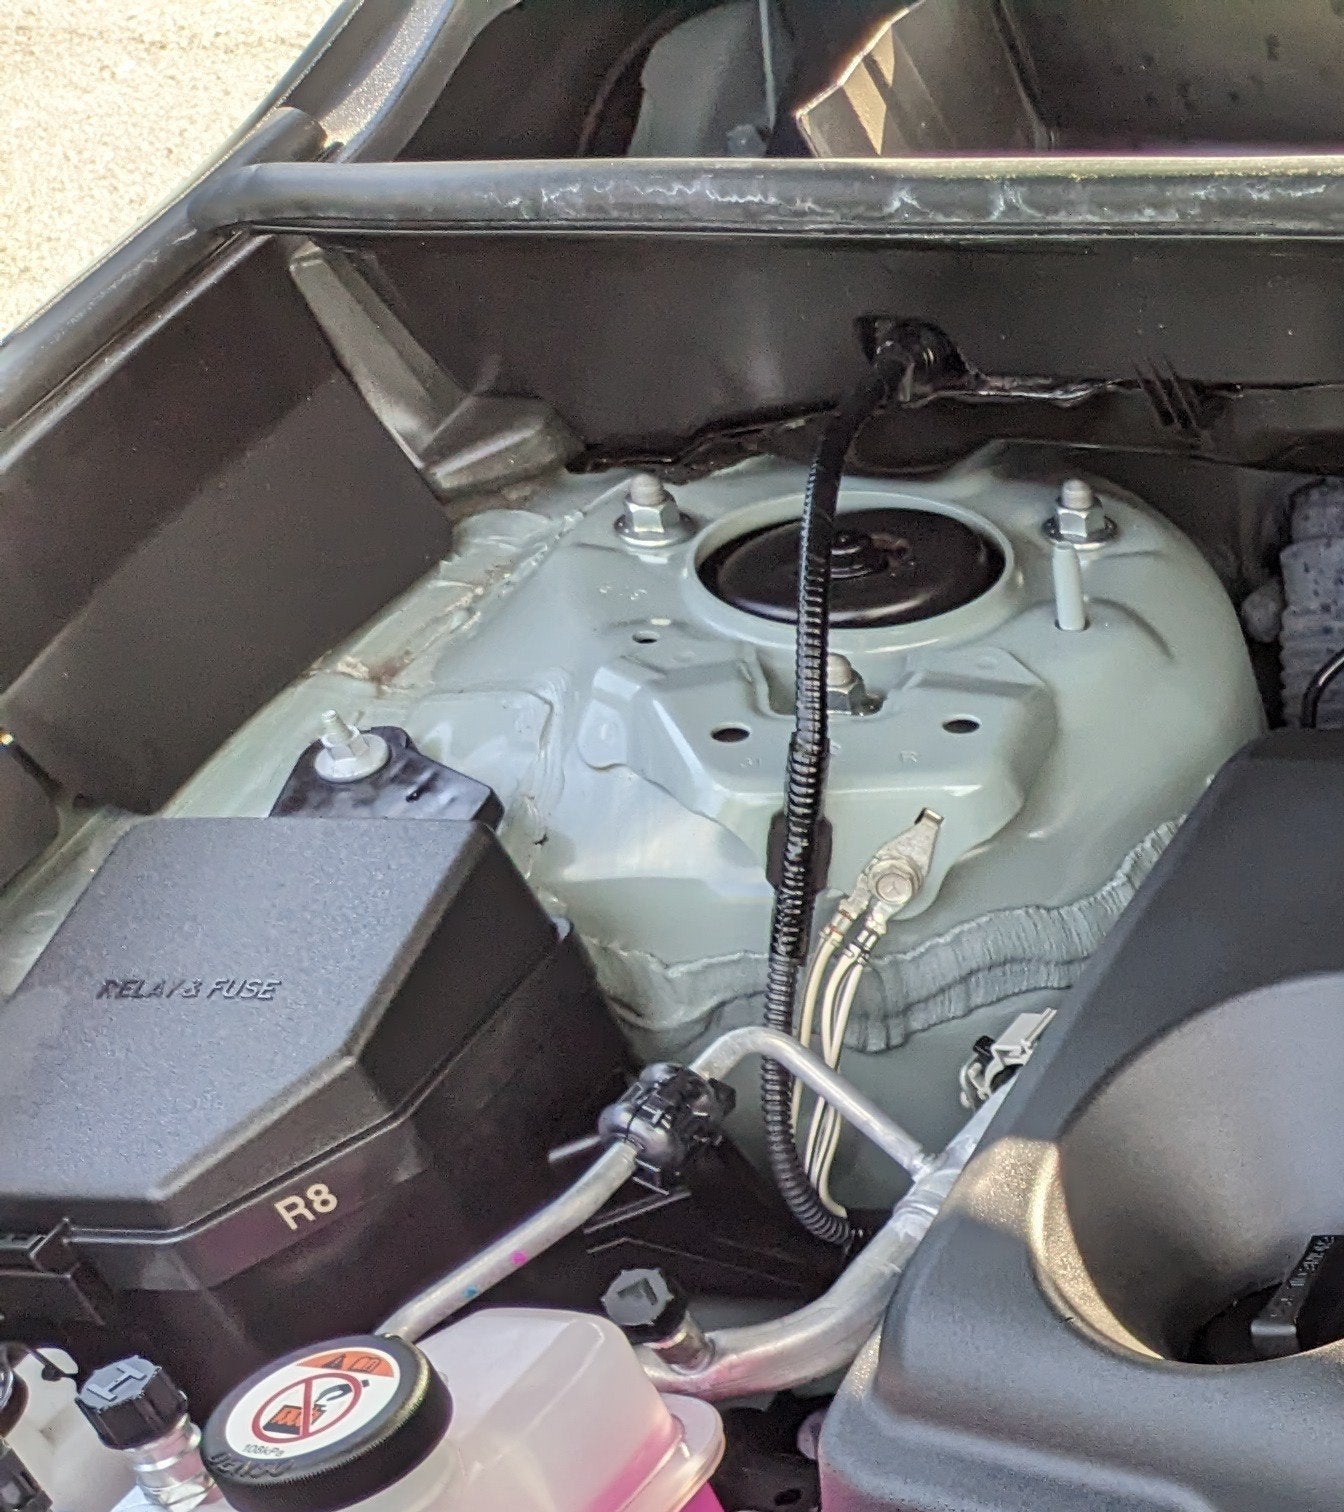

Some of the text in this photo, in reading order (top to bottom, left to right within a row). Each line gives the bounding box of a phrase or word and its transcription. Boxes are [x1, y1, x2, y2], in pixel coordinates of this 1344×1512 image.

[207, 979, 283, 1000] FUSE
[274, 1183, 338, 1230] R8
[86, 1362, 148, 1403] H
